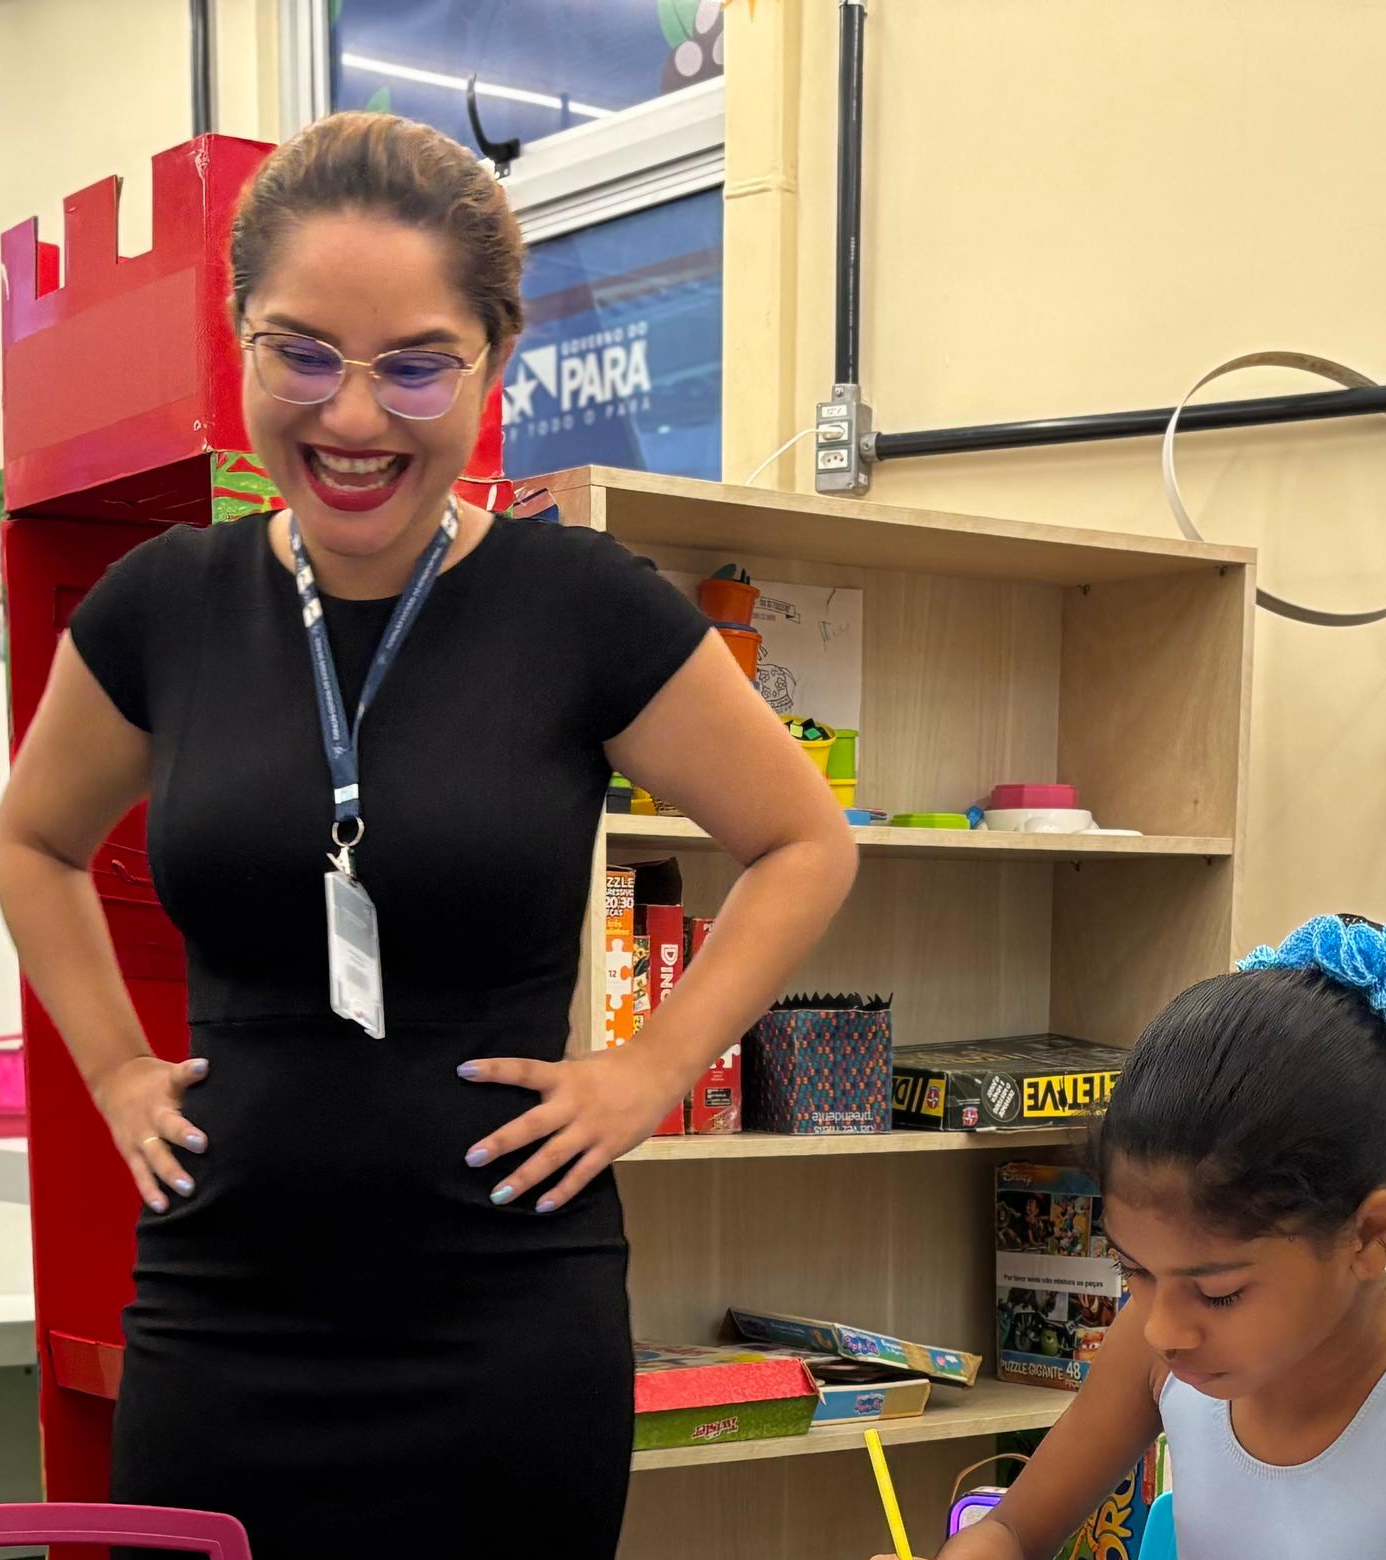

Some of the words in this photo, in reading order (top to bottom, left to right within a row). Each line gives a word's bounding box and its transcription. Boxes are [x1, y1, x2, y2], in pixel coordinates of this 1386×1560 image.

[561, 327, 624, 356] GOVERNO
[627, 320, 649, 339] DO
[561, 340, 652, 412] PARÁ
[606, 877, 634, 888] ZZLE
[1001, 1360, 1028, 1375] PUZZLE
[1029, 1363, 1063, 1380] GIGANTE
[1066, 1361, 1081, 1380] 48
